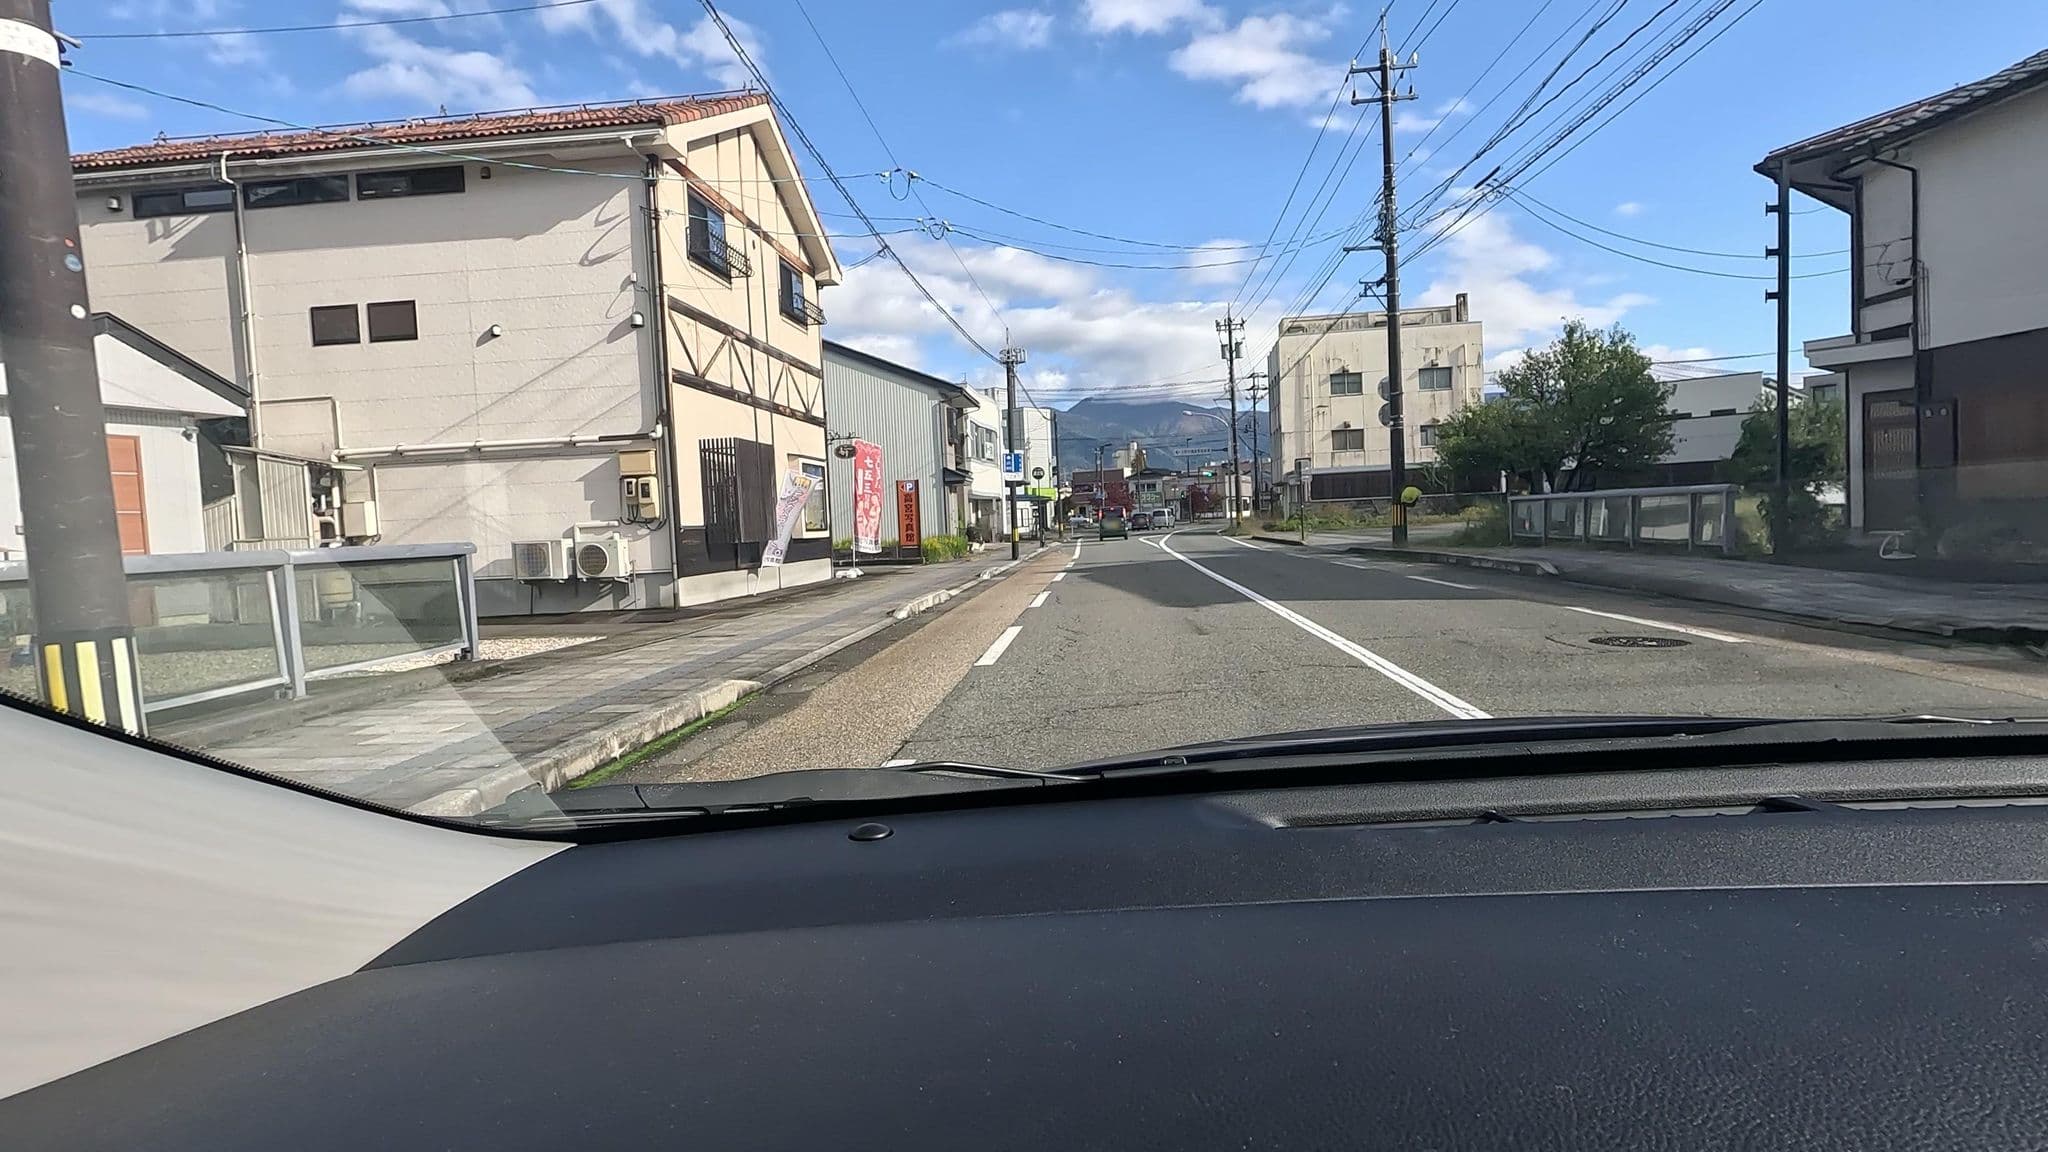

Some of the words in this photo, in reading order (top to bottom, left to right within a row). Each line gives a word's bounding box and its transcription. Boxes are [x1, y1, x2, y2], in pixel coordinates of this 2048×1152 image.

[864, 456, 874, 494] 七五三
[906, 483, 913, 492] P
[904, 493, 915, 542] 高宮写真館
